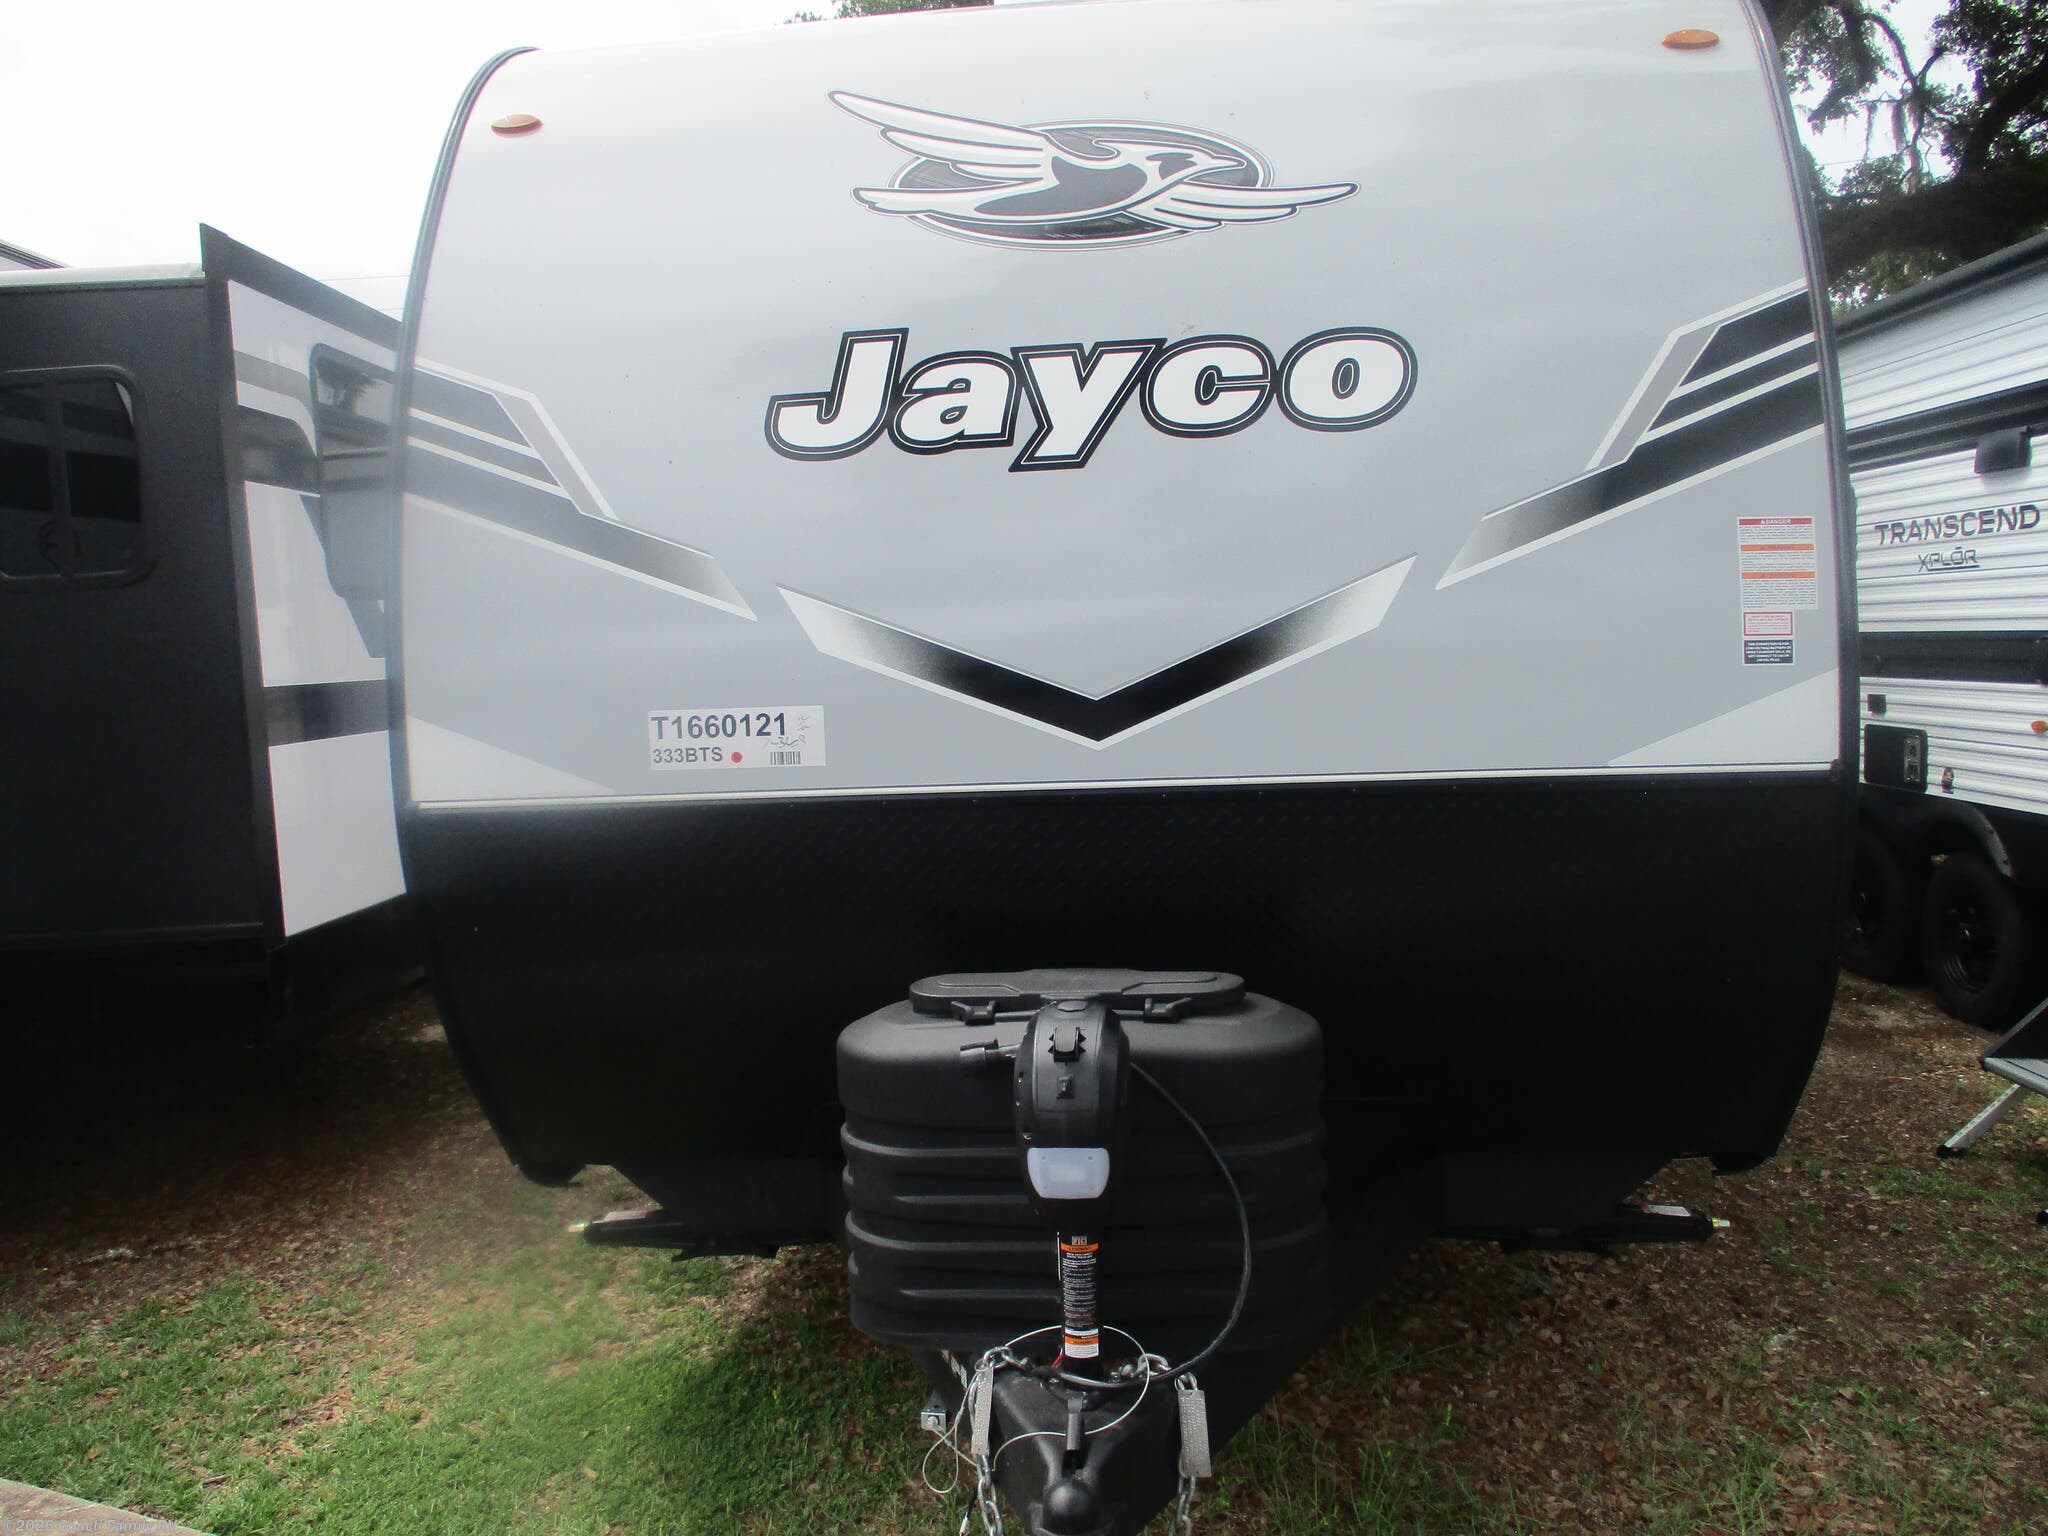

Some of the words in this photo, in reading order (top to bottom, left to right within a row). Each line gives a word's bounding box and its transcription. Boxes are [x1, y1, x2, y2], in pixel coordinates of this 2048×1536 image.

[764, 327, 1418, 472] Jayco
[1874, 504, 2040, 545] TRANSCEND
[651, 712, 786, 740] T1660121
[653, 746, 723, 764] 333BTS
